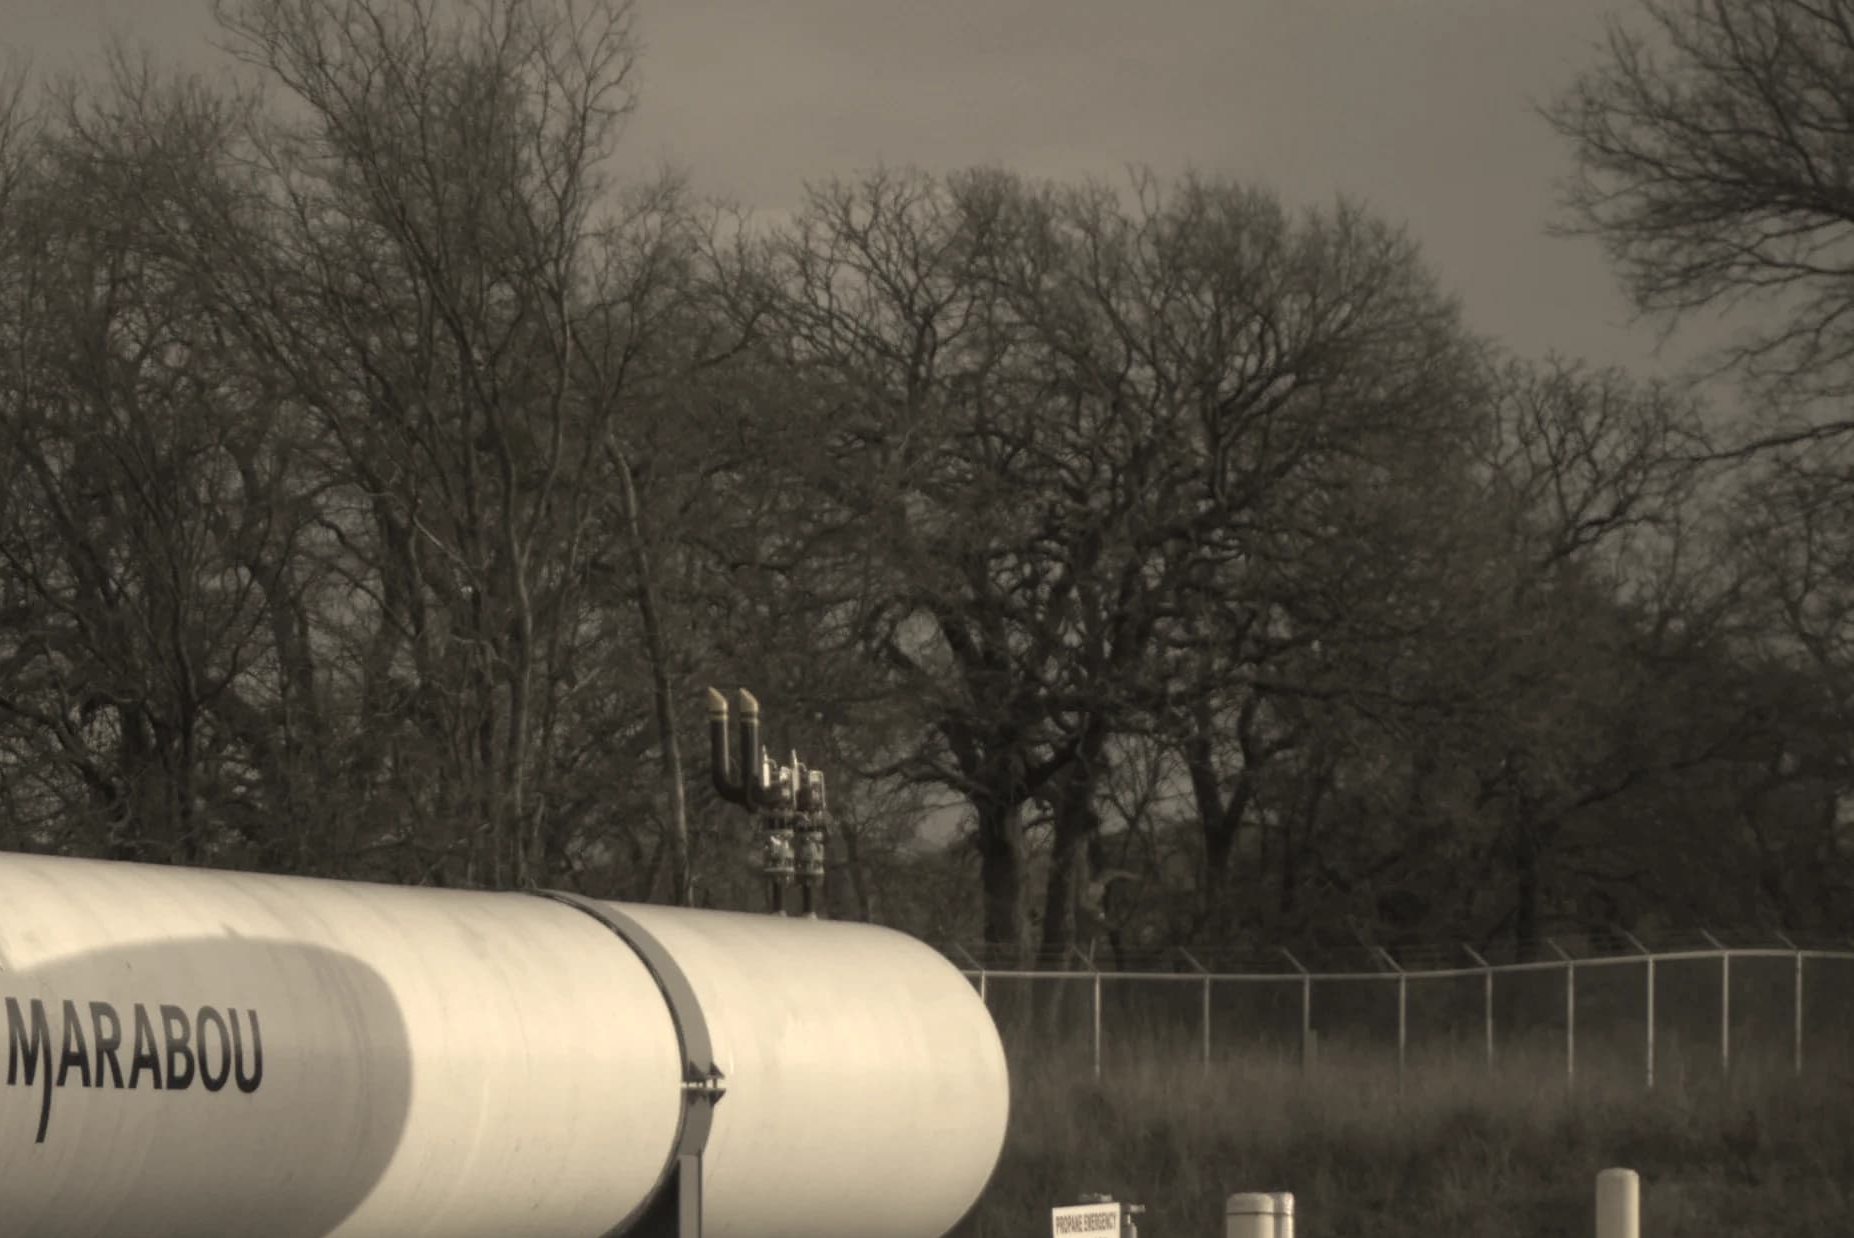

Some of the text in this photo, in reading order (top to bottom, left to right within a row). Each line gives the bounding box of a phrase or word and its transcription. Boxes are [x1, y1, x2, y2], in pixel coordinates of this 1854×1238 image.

[4, 996, 264, 1144] MARABOU
[1055, 1211, 1117, 1235] PROPANE EMERGENCY
